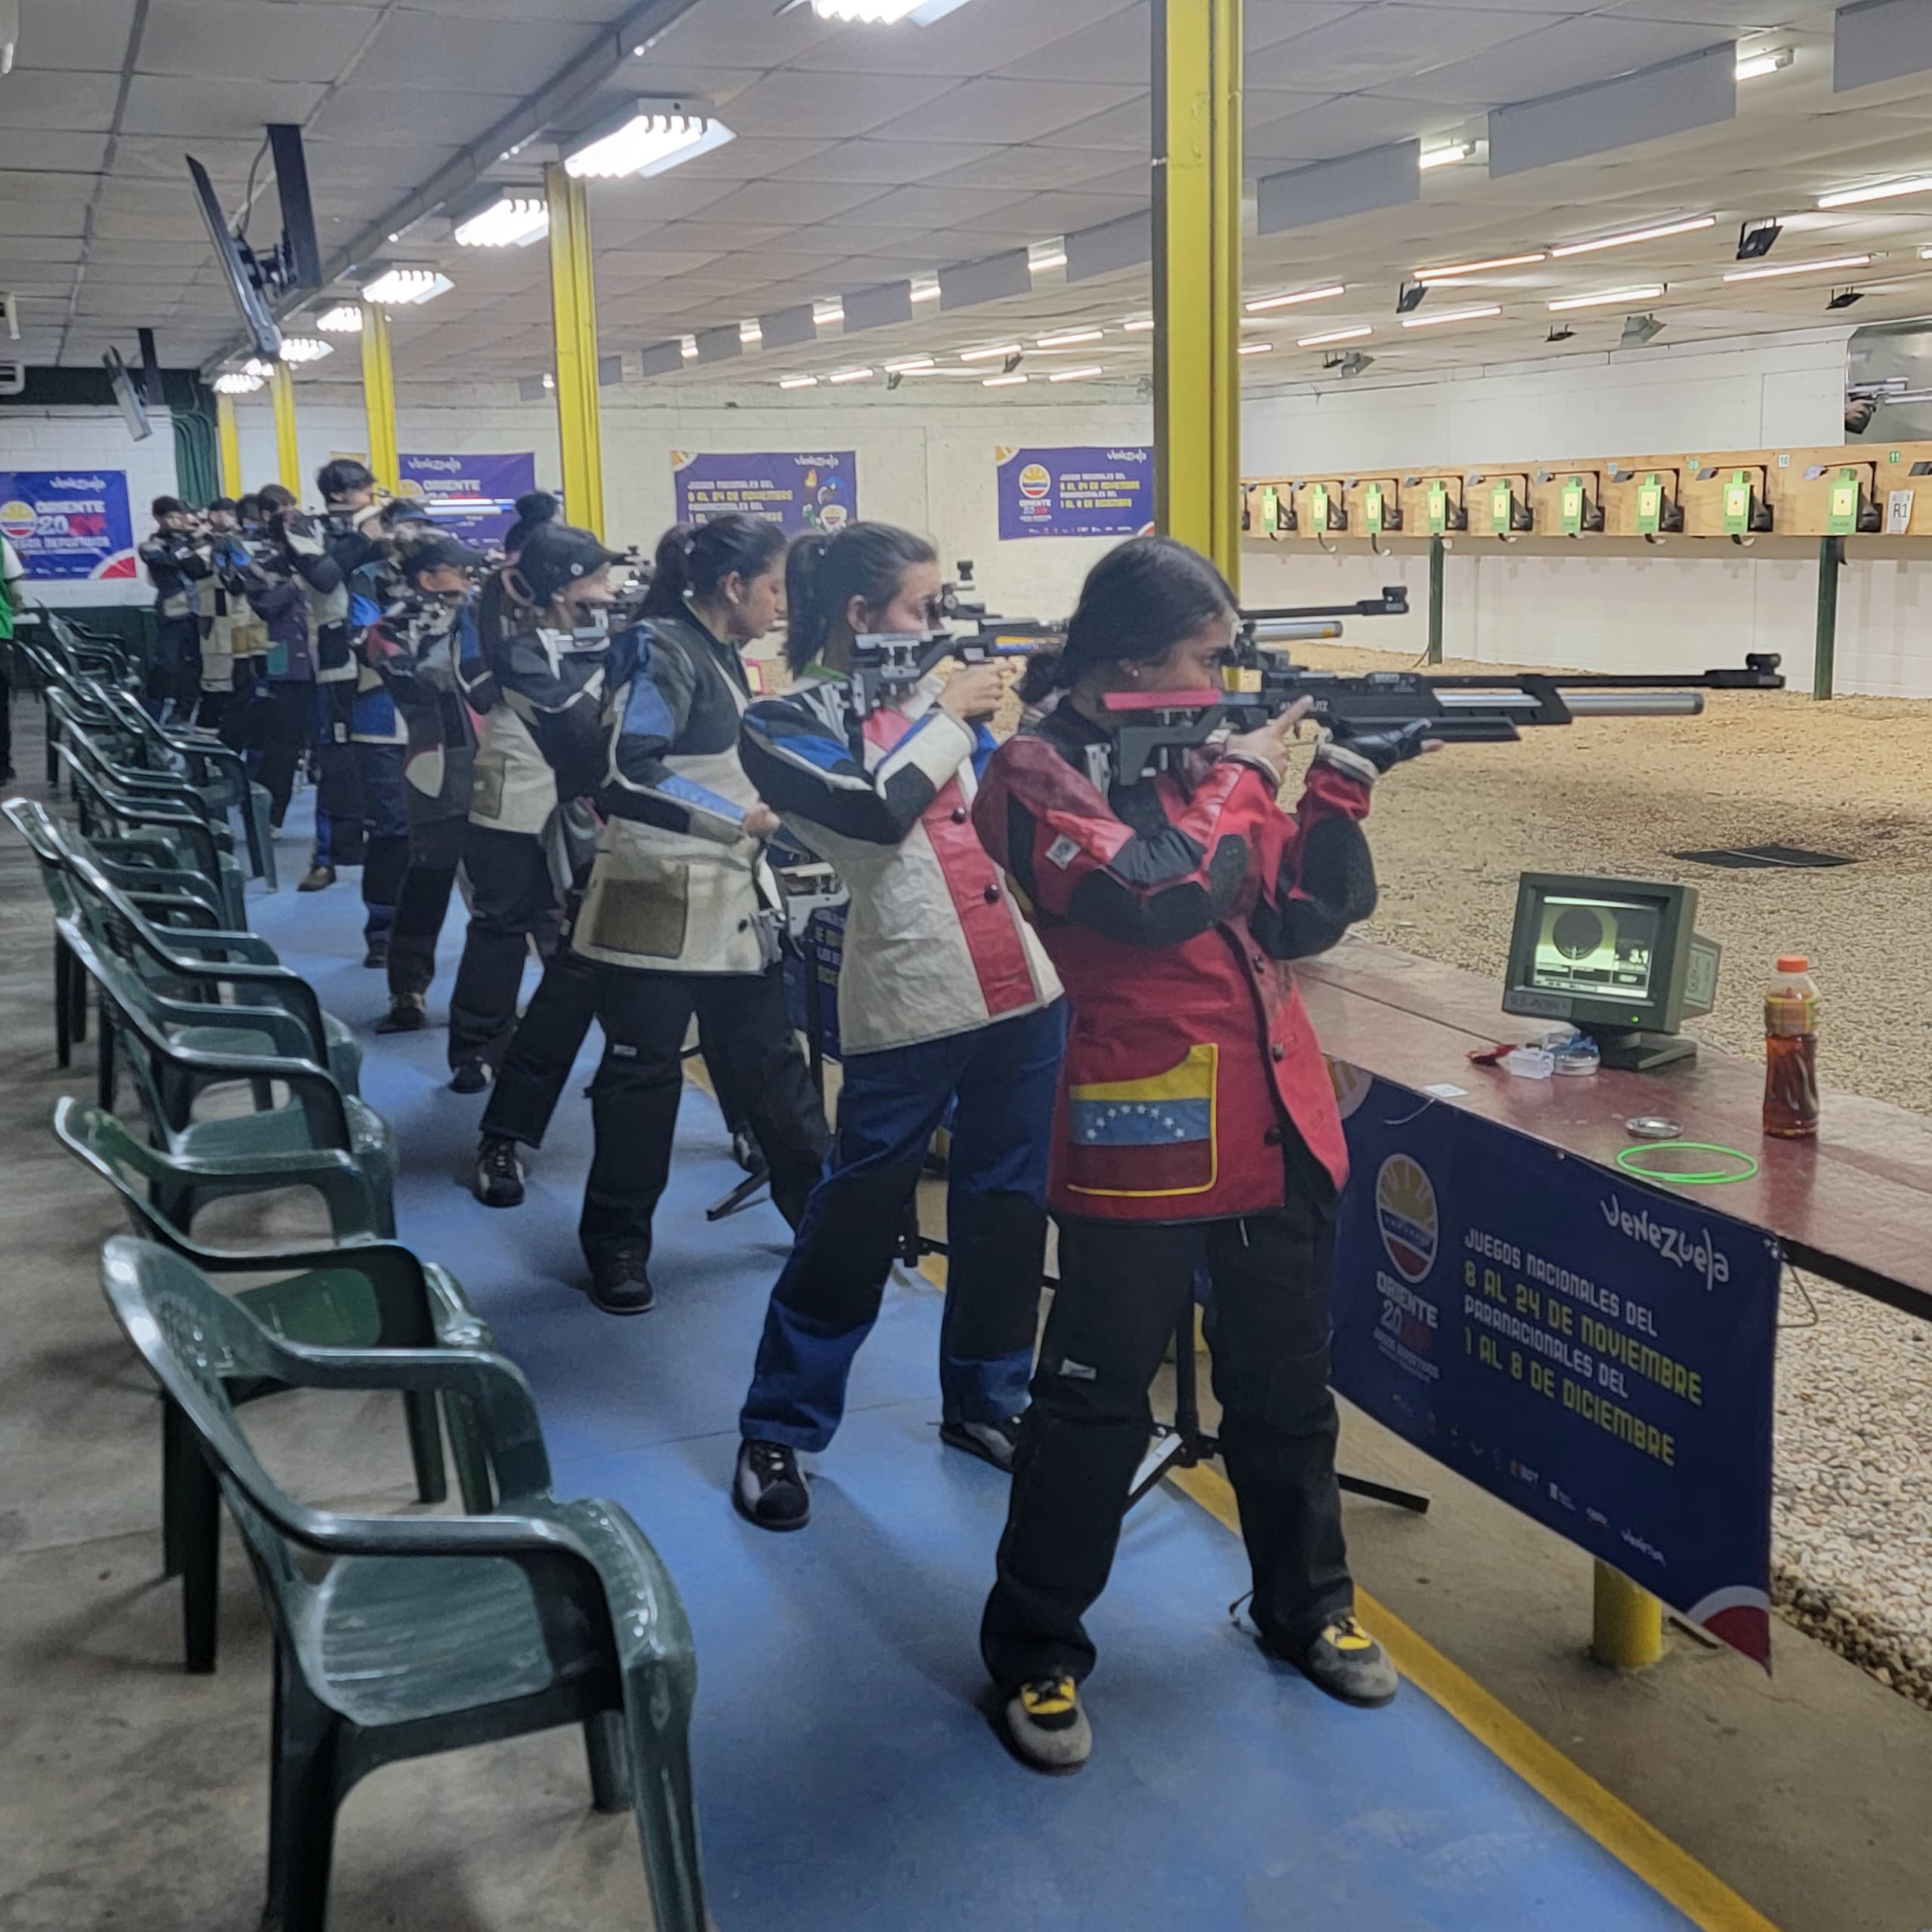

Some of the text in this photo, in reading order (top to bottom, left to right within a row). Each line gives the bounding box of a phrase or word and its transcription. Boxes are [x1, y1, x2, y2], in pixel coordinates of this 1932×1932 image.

[1893, 503, 1907, 518] R1
[1377, 1270, 1438, 1328] ORIENTE
[1464, 1228, 1658, 1338] JUEGOS NACIONALES DEL
[1465, 1260, 1703, 1406] 8 AL 24 DE NOVIEMBRE
[1465, 1294, 1593, 1378] PARANACIONALES
[1598, 1362, 1629, 1399] DEL
[1465, 1326, 1472, 1355] 1
[1479, 1335, 1503, 1371] AL
[1511, 1352, 1523, 1381] 8
[1531, 1360, 1555, 1399] DE
[1562, 1377, 1675, 1468] DICIEMBRE
